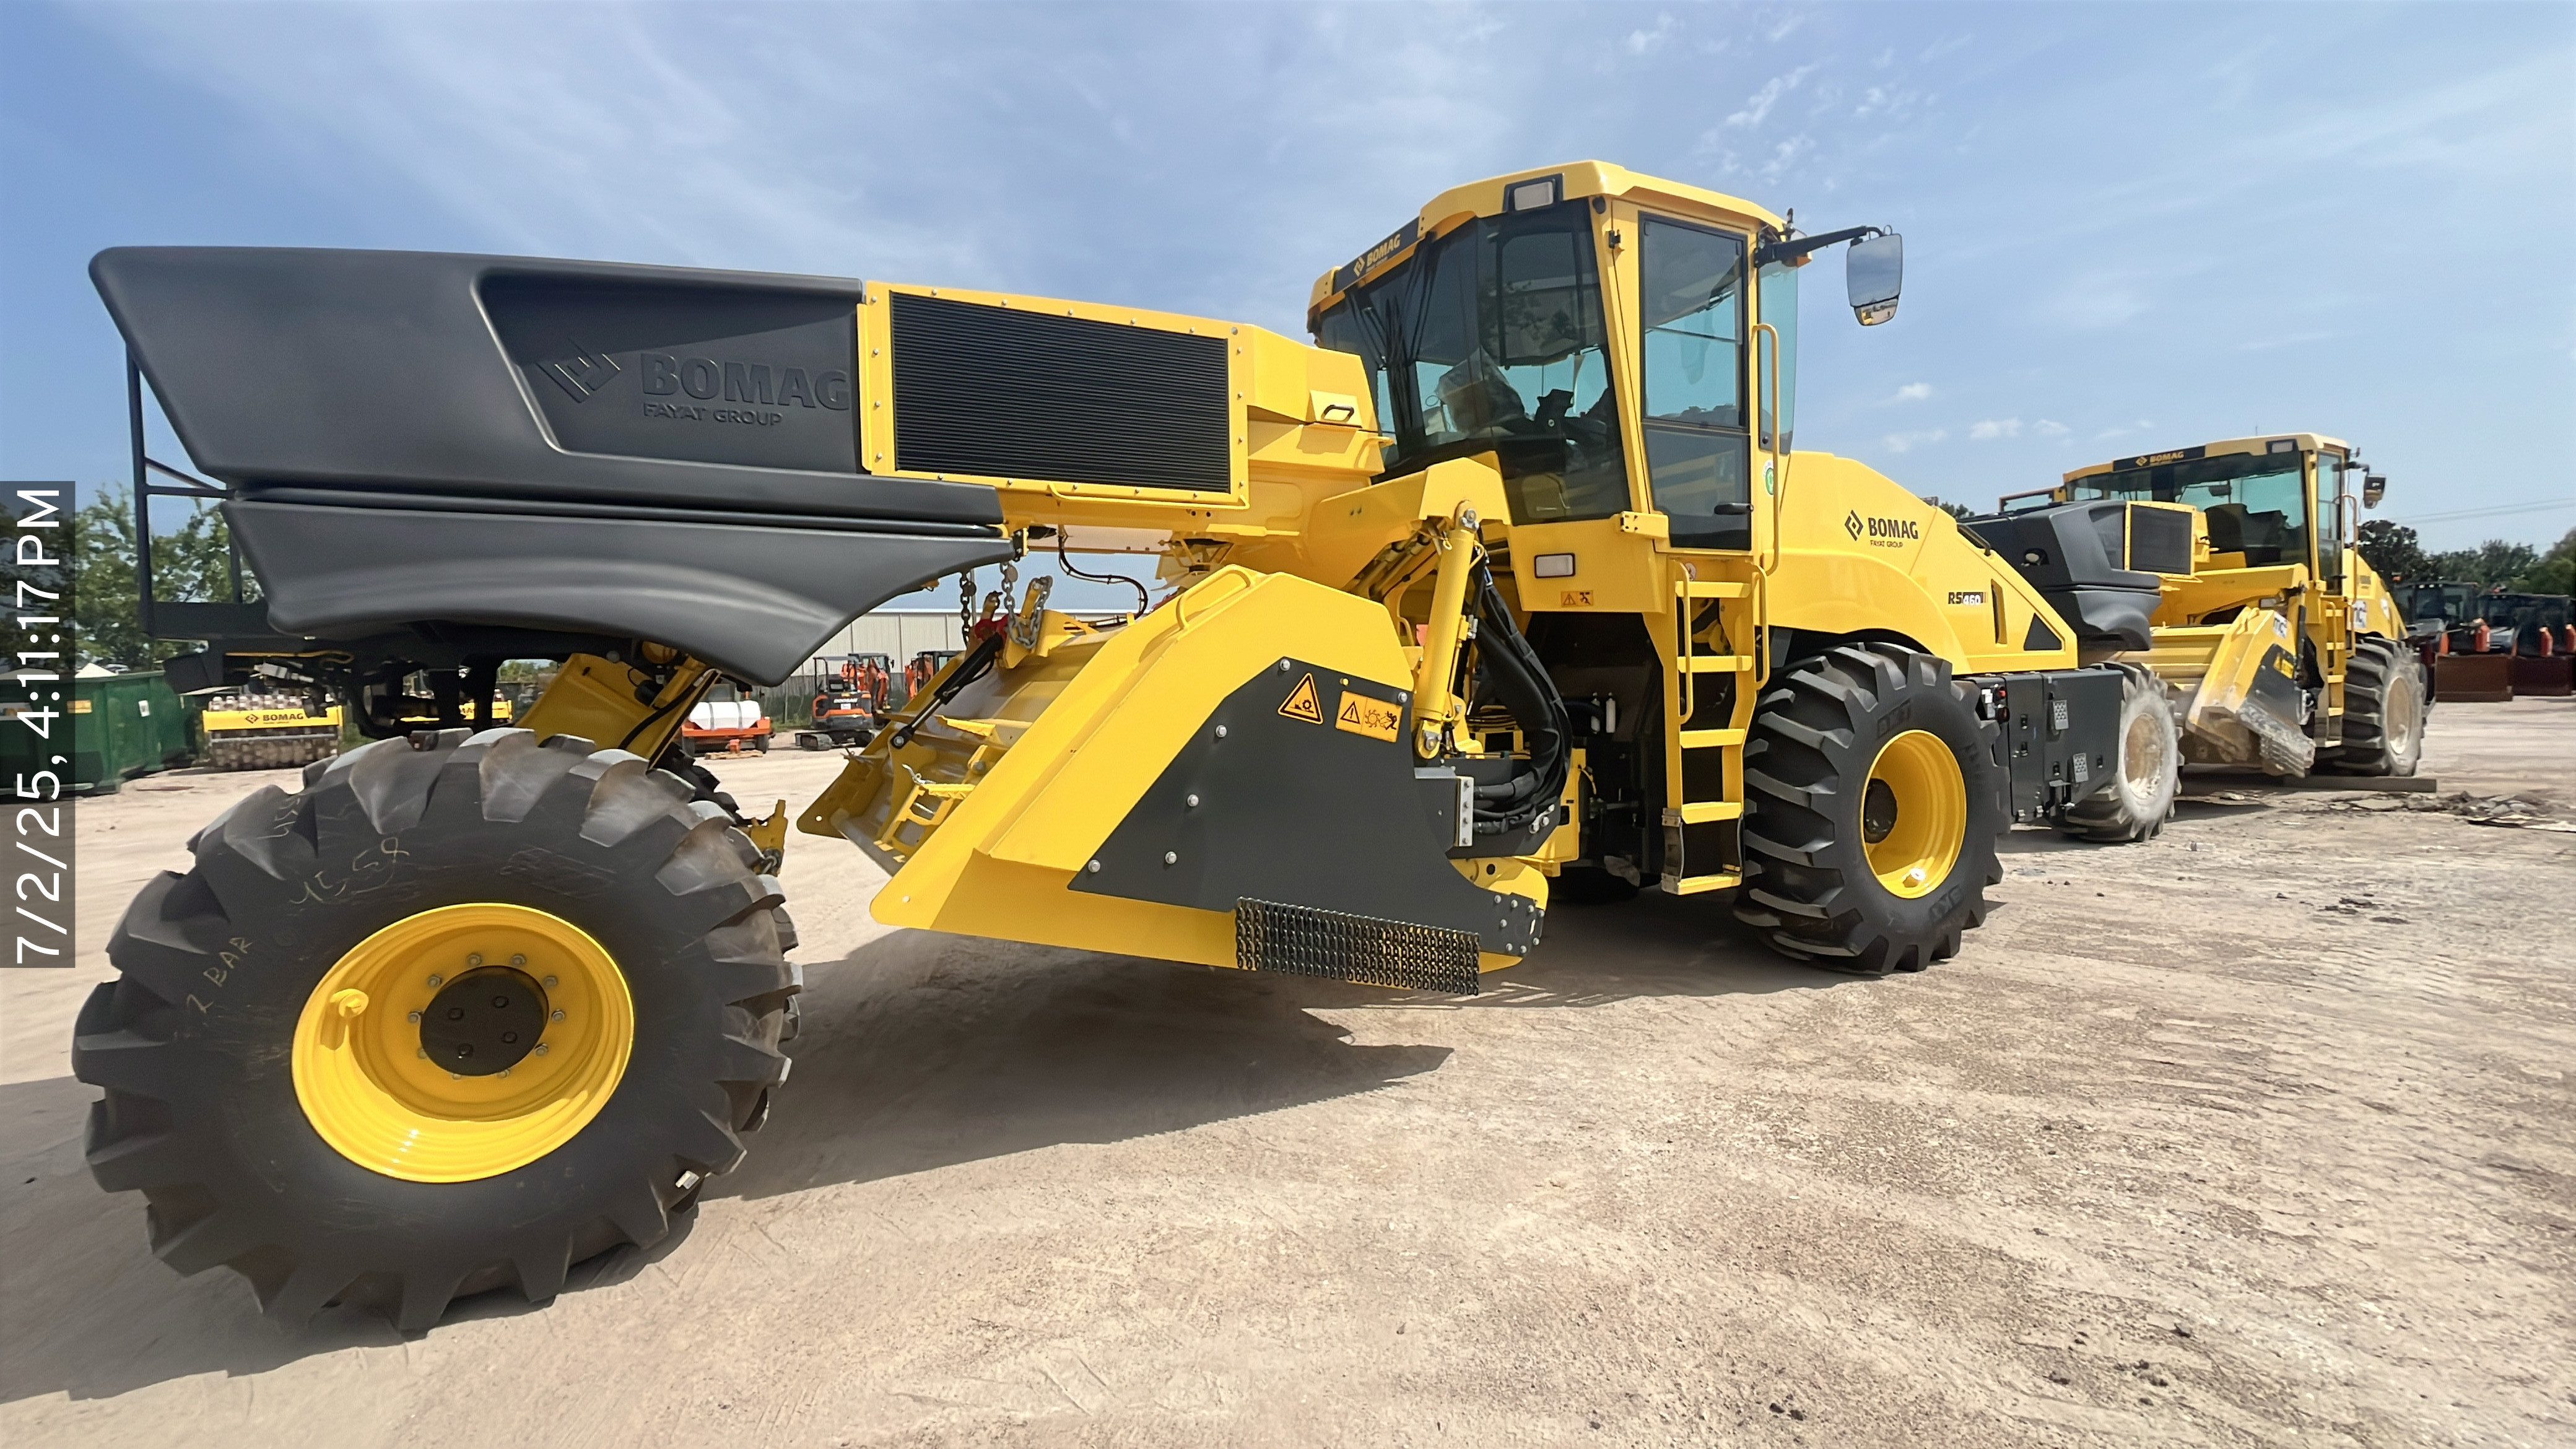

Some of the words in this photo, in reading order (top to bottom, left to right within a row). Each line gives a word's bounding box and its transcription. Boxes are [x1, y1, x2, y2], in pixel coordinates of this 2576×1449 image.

[1367, 233, 1401, 267] BOMAG
[640, 353, 850, 411] BOMAG
[643, 402, 707, 421] FAYAT
[713, 409, 783, 426] GROUP
[2149, 451, 2185, 463] BOMAG
[1868, 517, 1918, 539] BOMAG
[263, 713, 304, 721] BOMAG
[203, 937, 253, 988] BAR
